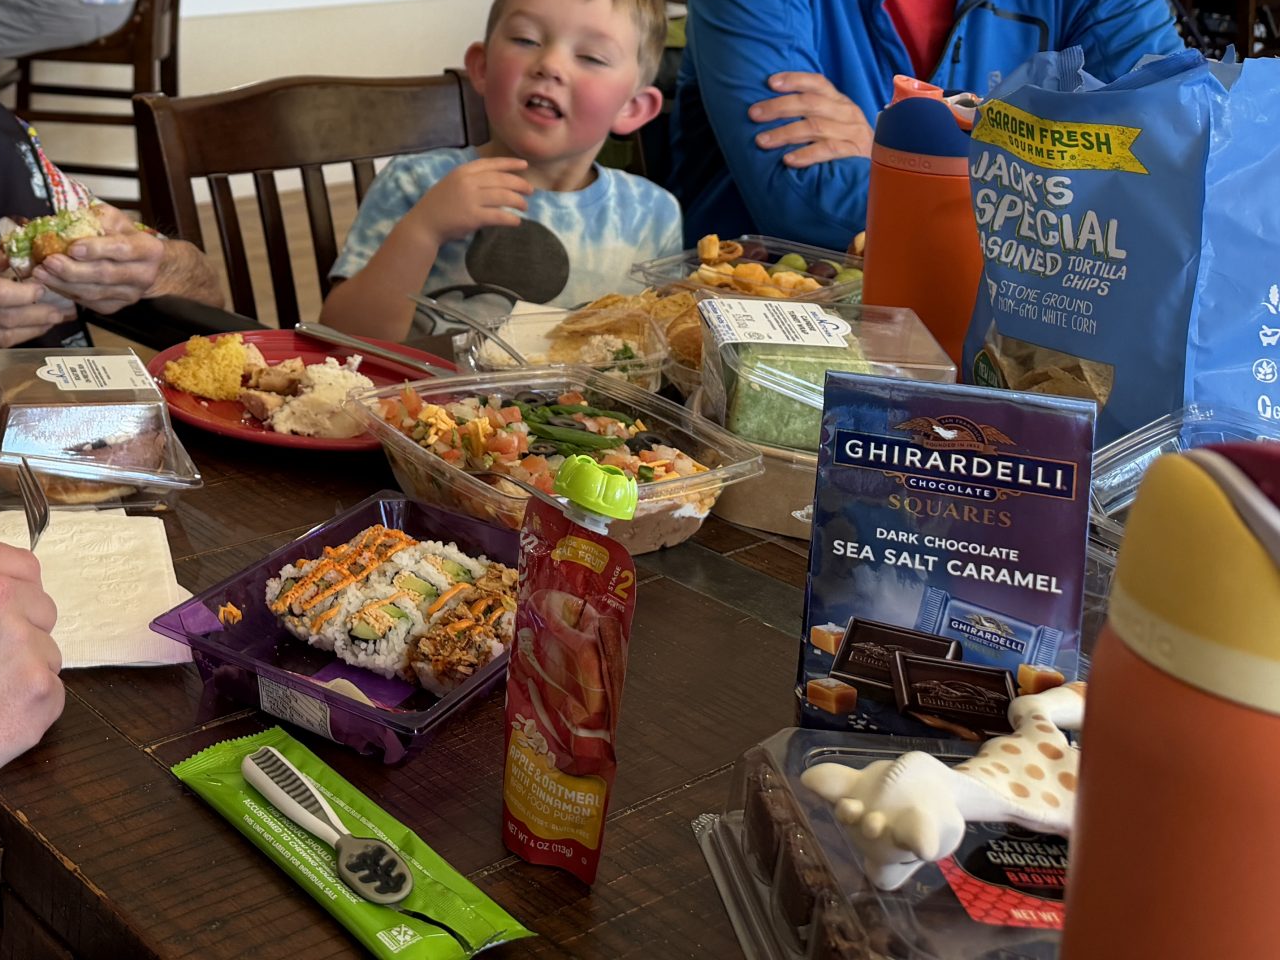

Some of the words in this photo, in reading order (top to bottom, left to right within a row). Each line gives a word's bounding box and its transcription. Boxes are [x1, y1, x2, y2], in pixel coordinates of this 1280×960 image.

[986, 106, 1035, 141] GARDEN
[1039, 127, 1112, 155] FRESH
[1008, 135, 1067, 161] GOURMET
[972, 151, 1073, 205] JACK'S
[976, 188, 1127, 259] SPECIAL
[979, 231, 1062, 276] ASONED
[1068, 256, 1127, 280] TORTILLA
[998, 280, 1040, 303] STONE
[1042, 292, 1093, 316] GROUND
[1062, 273, 1111, 296] CHIPS
[998, 296, 1038, 320] NON-GMO
[1041, 308, 1068, 328] WHITE
[1072, 315, 1097, 335] CORN
[844, 439, 1063, 490] GHIRARDELLI
[909, 477, 992, 498] CHOCOLATE
[887, 493, 1012, 528] SQUARES
[578, 551, 605, 569] FRUIT
[876, 527, 919, 545] DARK
[924, 535, 1020, 562] CHOCOLATE
[608, 565, 622, 591] STAGE
[614, 570, 634, 599] 2
[832, 539, 875, 562] SEA
[884, 548, 938, 572] SALT
[947, 559, 1063, 594] CARAMEL
[951, 620, 1024, 652] GHIRARDELLI
[509, 745, 535, 776] APPLE
[534, 768, 541, 782] &
[542, 775, 600, 807] OATMEAL
[511, 763, 530, 786] WITH
[531, 783, 591, 816] CINNAMON
[527, 794, 550, 814] FOOD
[243, 798, 280, 833] ACCUSTOMED
[289, 839, 318, 869] CHEWING
[280, 815, 306, 840] PRODUCT
[305, 837, 332, 862] SHOULD
[508, 820, 518, 836] NET
[518, 831, 529, 844] WT
[529, 838, 535, 847] 4
[536, 841, 550, 850] OZ
[551, 843, 573, 857] (113g)
[272, 840, 290, 858] LABELED
[298, 864, 326, 888] INDIVIDUAL
[986, 850, 1068, 868] CHOCOLA
[1010, 908, 1037, 921] NET
[1037, 910, 1061, 923] WT
